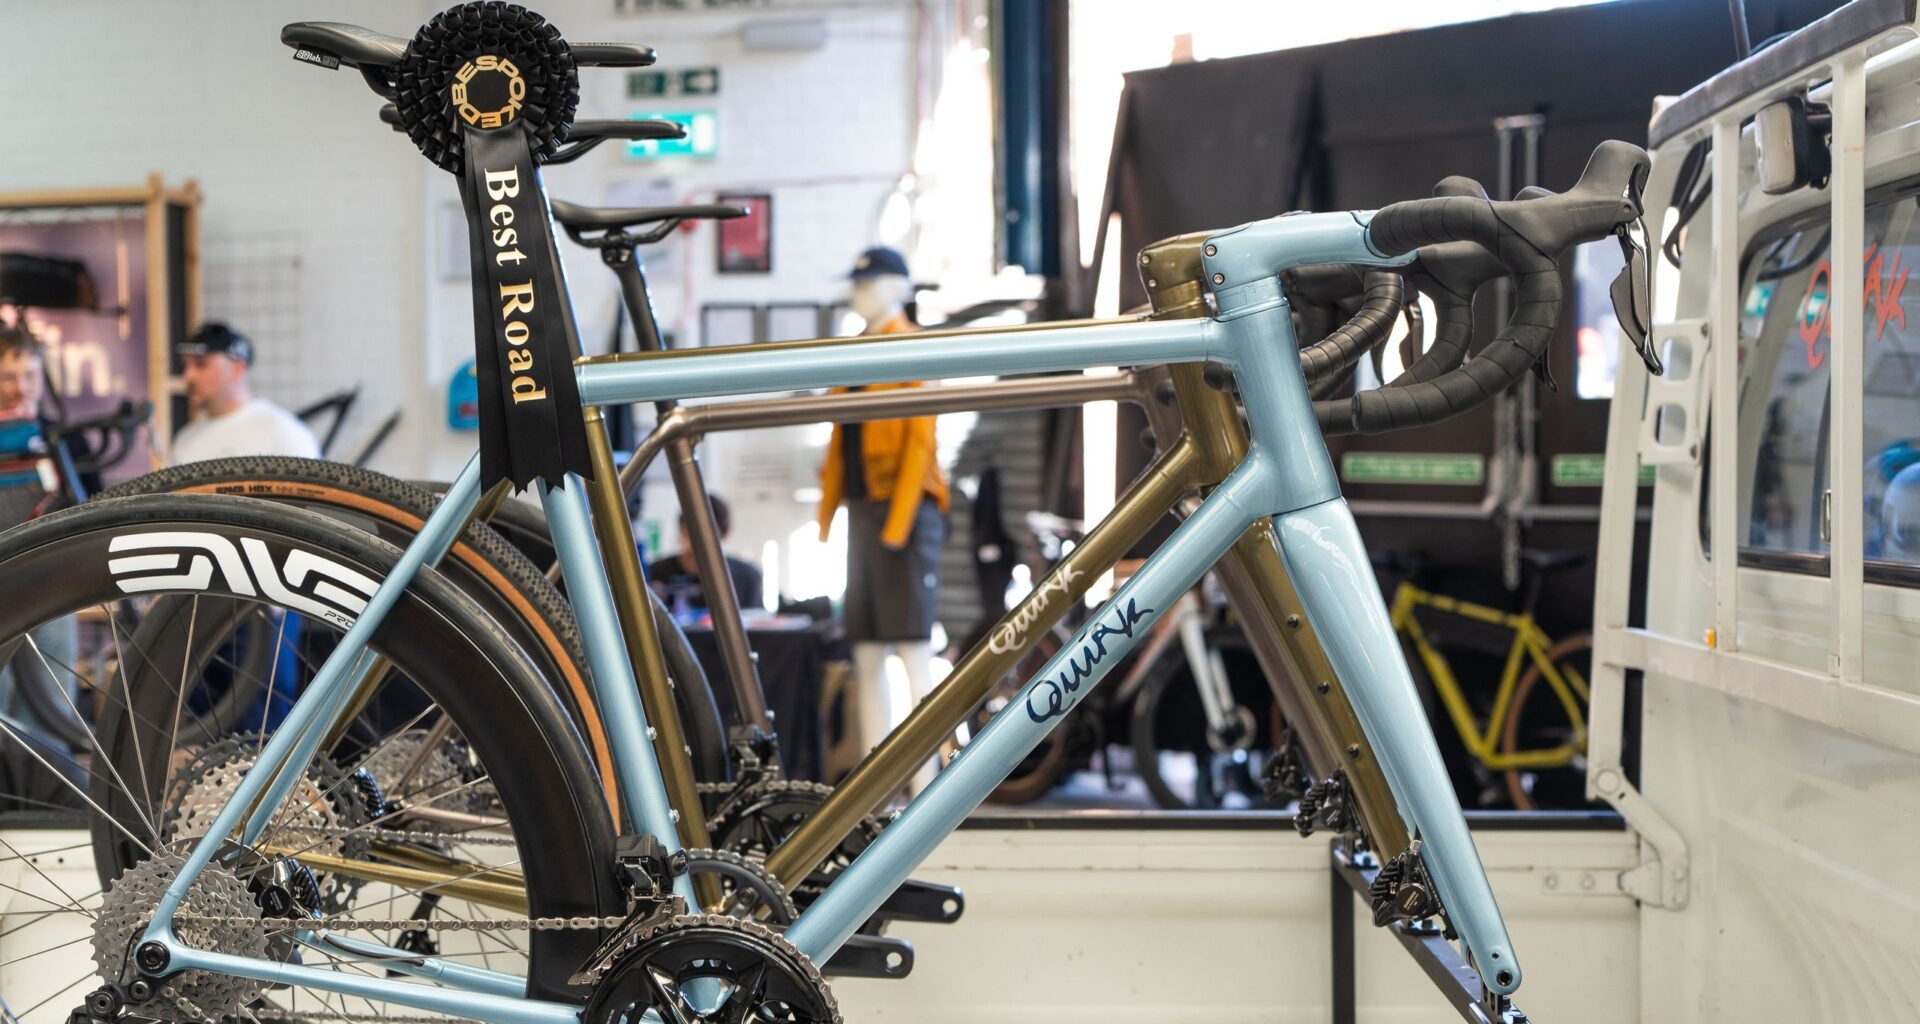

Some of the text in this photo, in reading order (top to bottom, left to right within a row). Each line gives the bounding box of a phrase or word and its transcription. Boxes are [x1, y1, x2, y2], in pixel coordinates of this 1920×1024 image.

[452, 55, 525, 128] BESPOKED
[484, 165, 547, 405] Best Road
